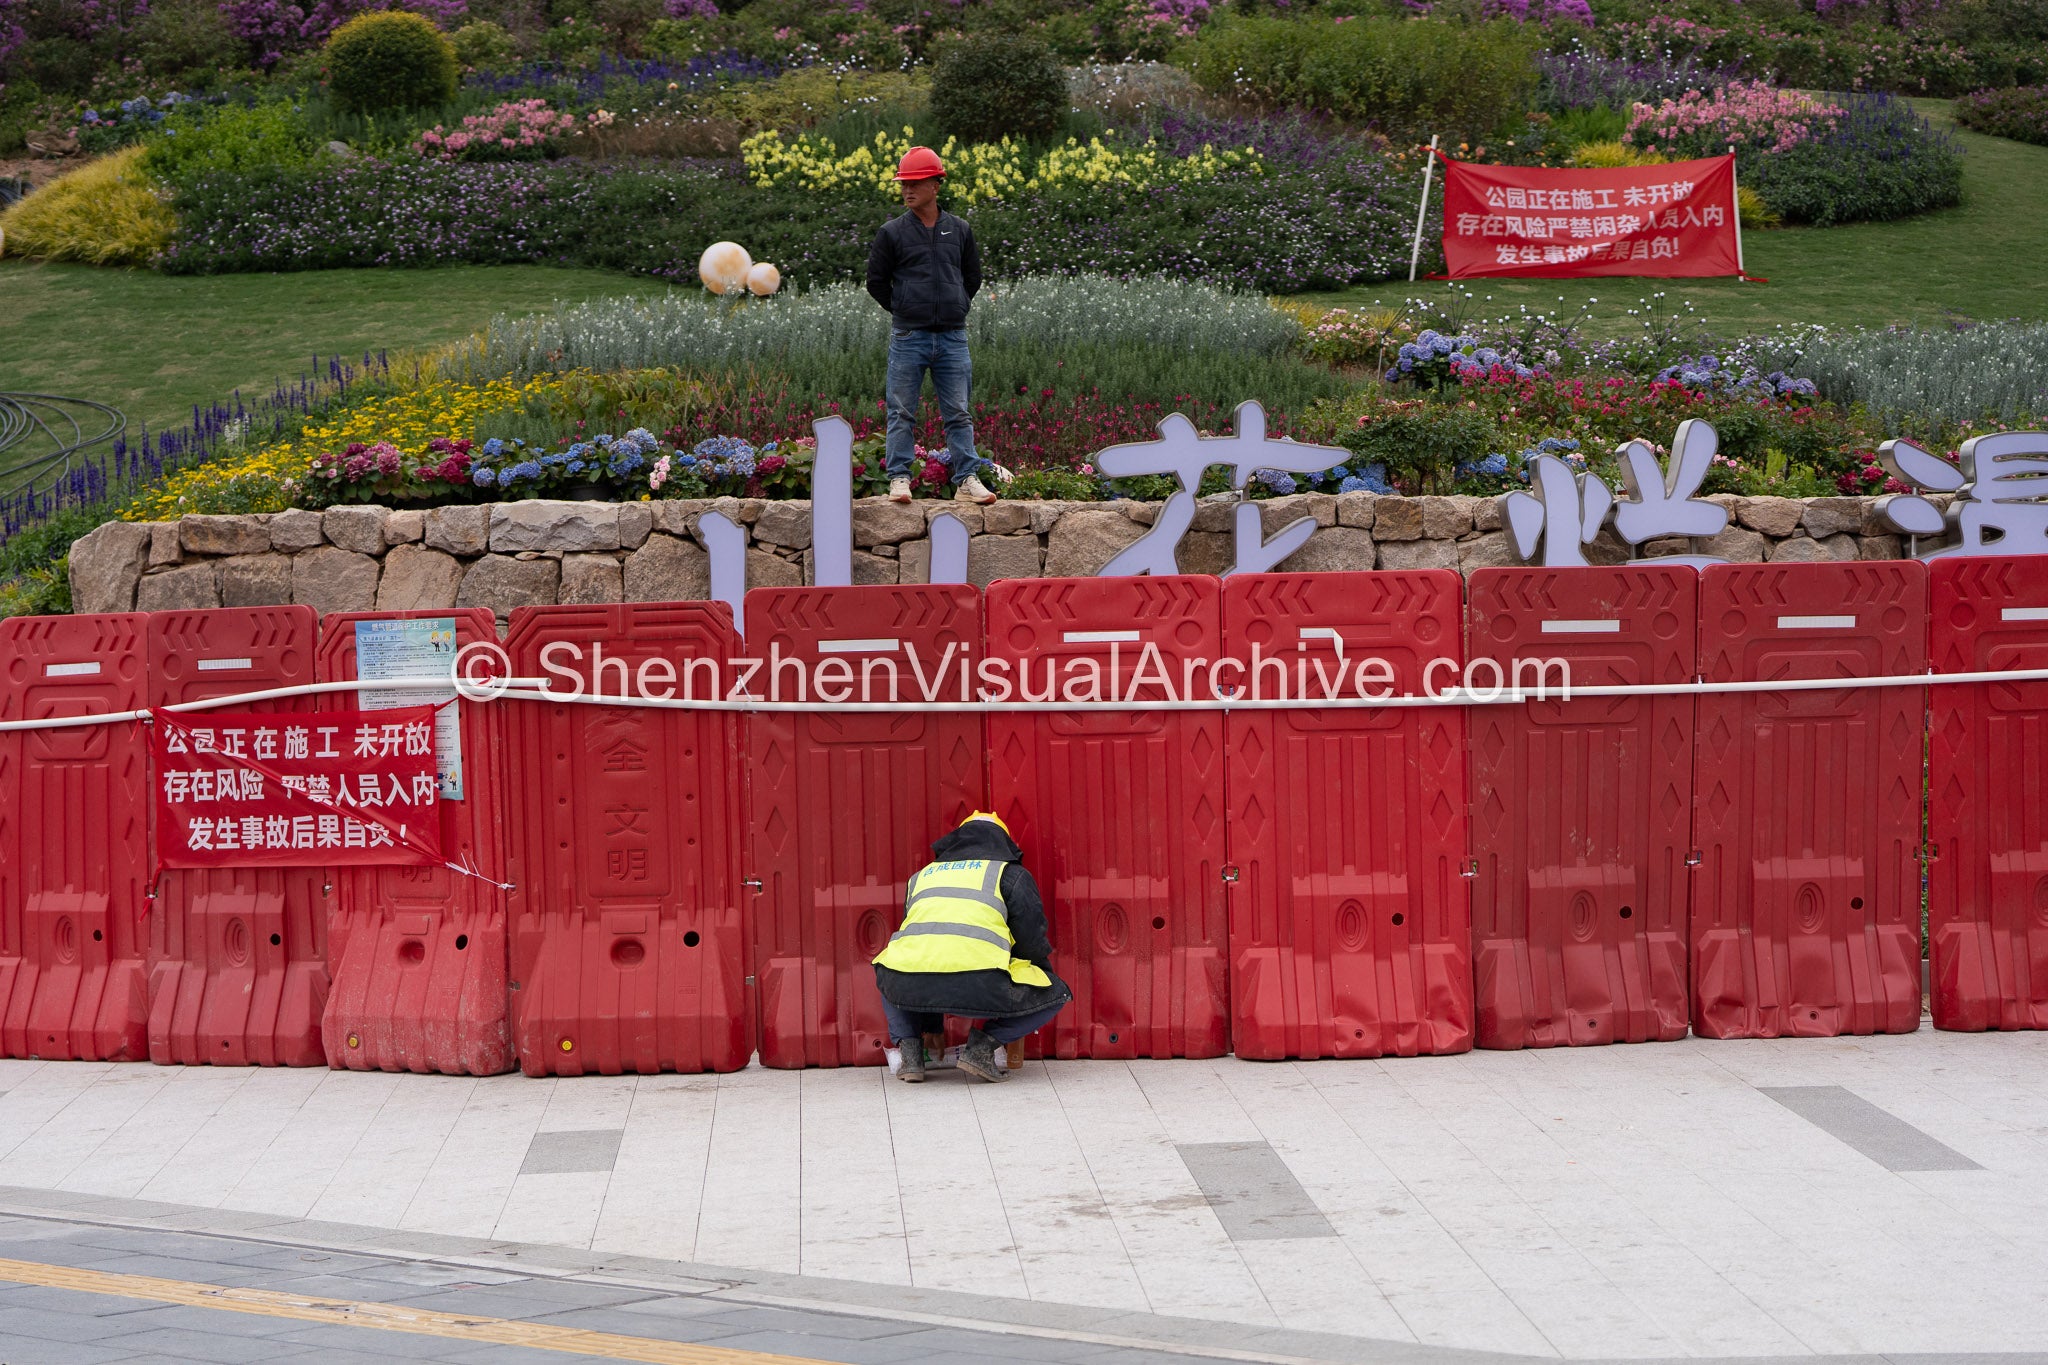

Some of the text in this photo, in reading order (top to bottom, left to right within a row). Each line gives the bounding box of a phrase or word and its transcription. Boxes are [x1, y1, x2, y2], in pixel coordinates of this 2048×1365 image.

[1485, 181, 1695, 210] 公园正在施工 未开放
[1456, 204, 1724, 239] 存在风险严禁闲杂人员入内
[354, 721, 432, 758] 未开放
[163, 768, 265, 803] 存在风险
